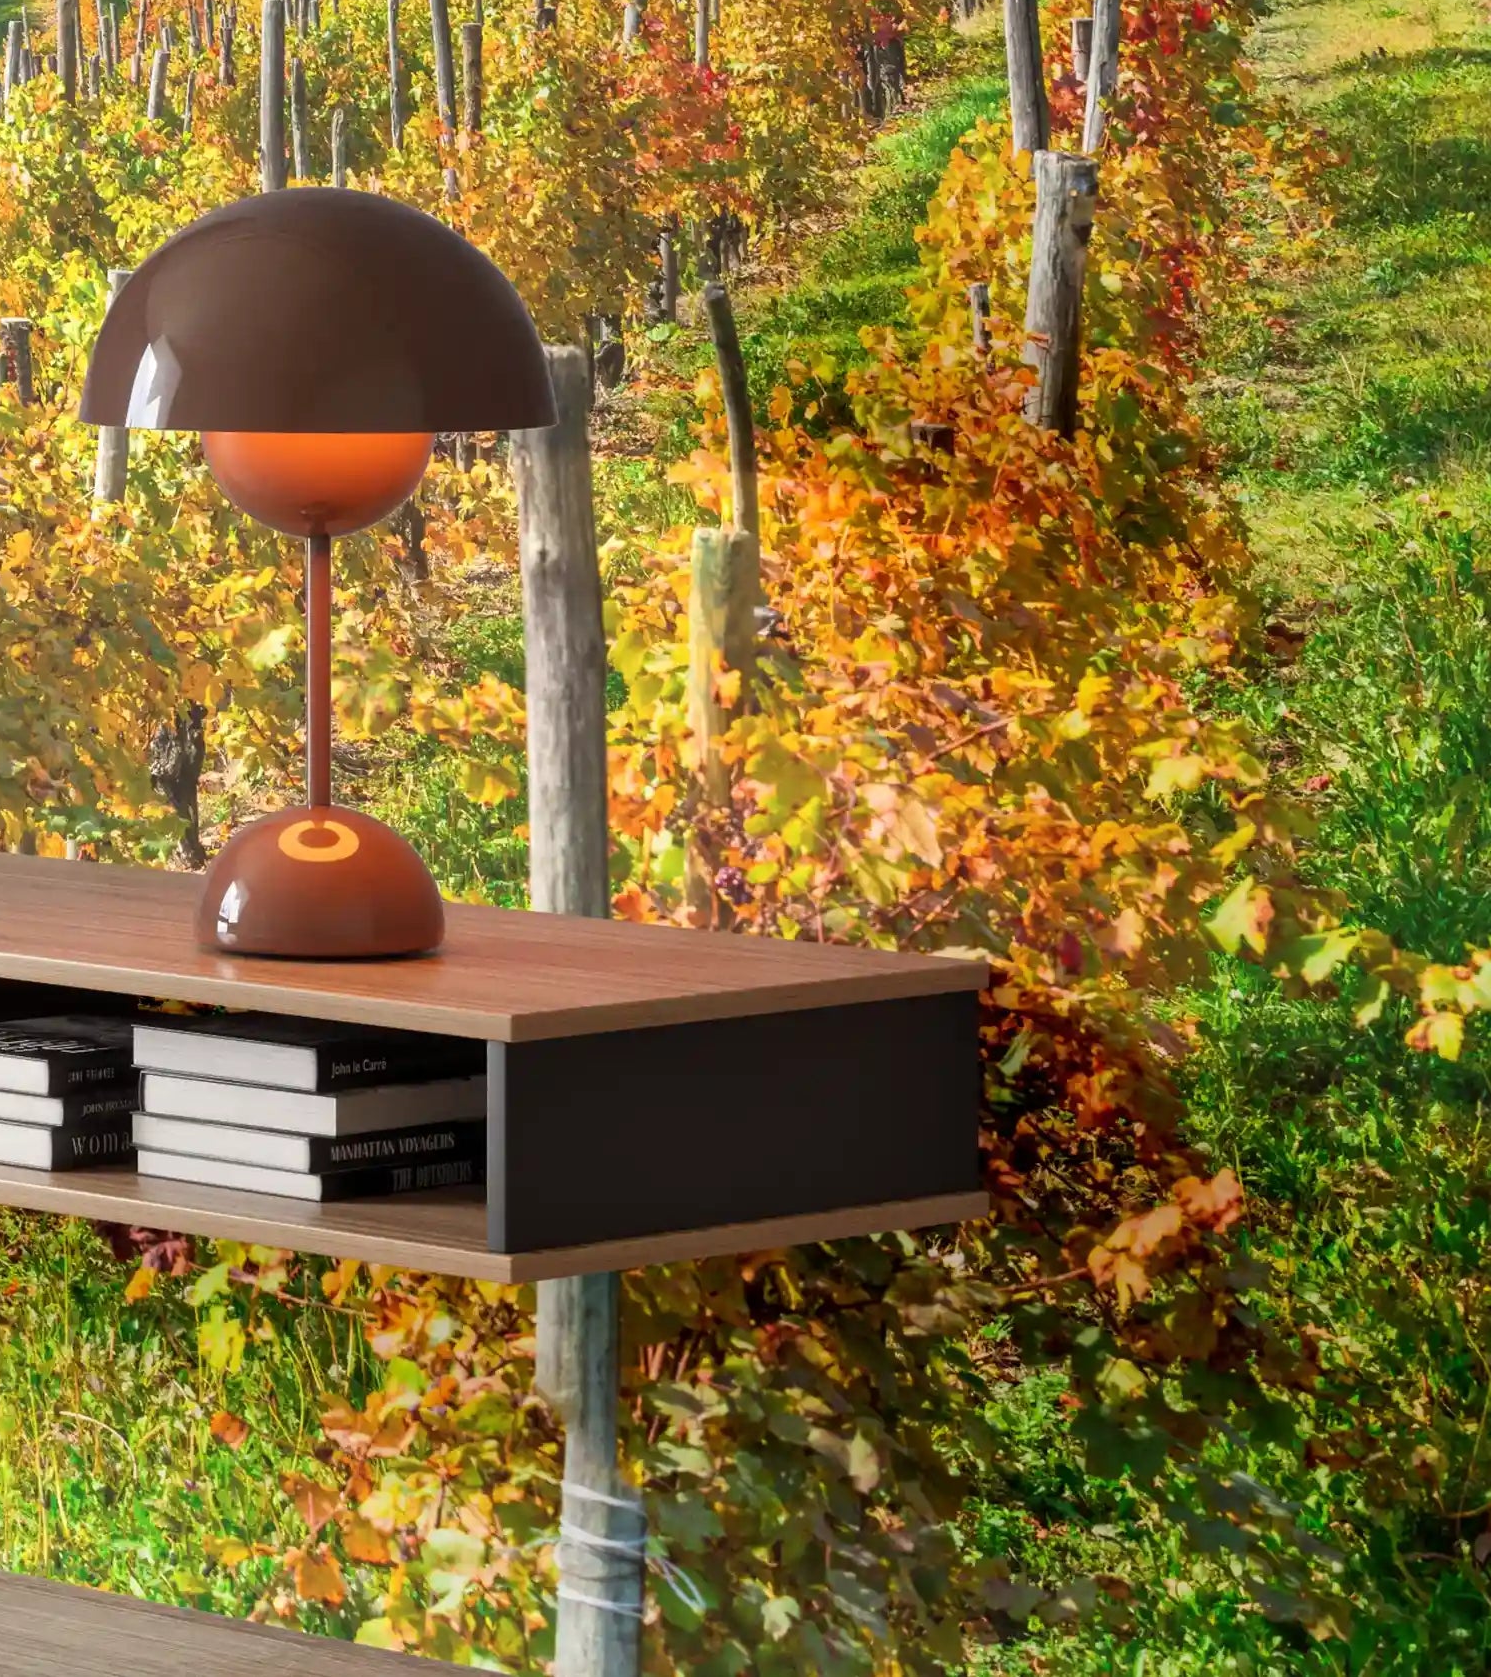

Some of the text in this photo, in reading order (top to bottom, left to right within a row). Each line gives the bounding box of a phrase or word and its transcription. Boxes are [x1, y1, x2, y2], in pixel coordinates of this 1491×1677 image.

[332, 1063, 351, 1078] John
[353, 1061, 361, 1073] le
[81, 1102, 104, 1117] JOHN
[72, 1132, 130, 1155] woma
[331, 1132, 455, 1163] MANHATTAN VOYAGERS
